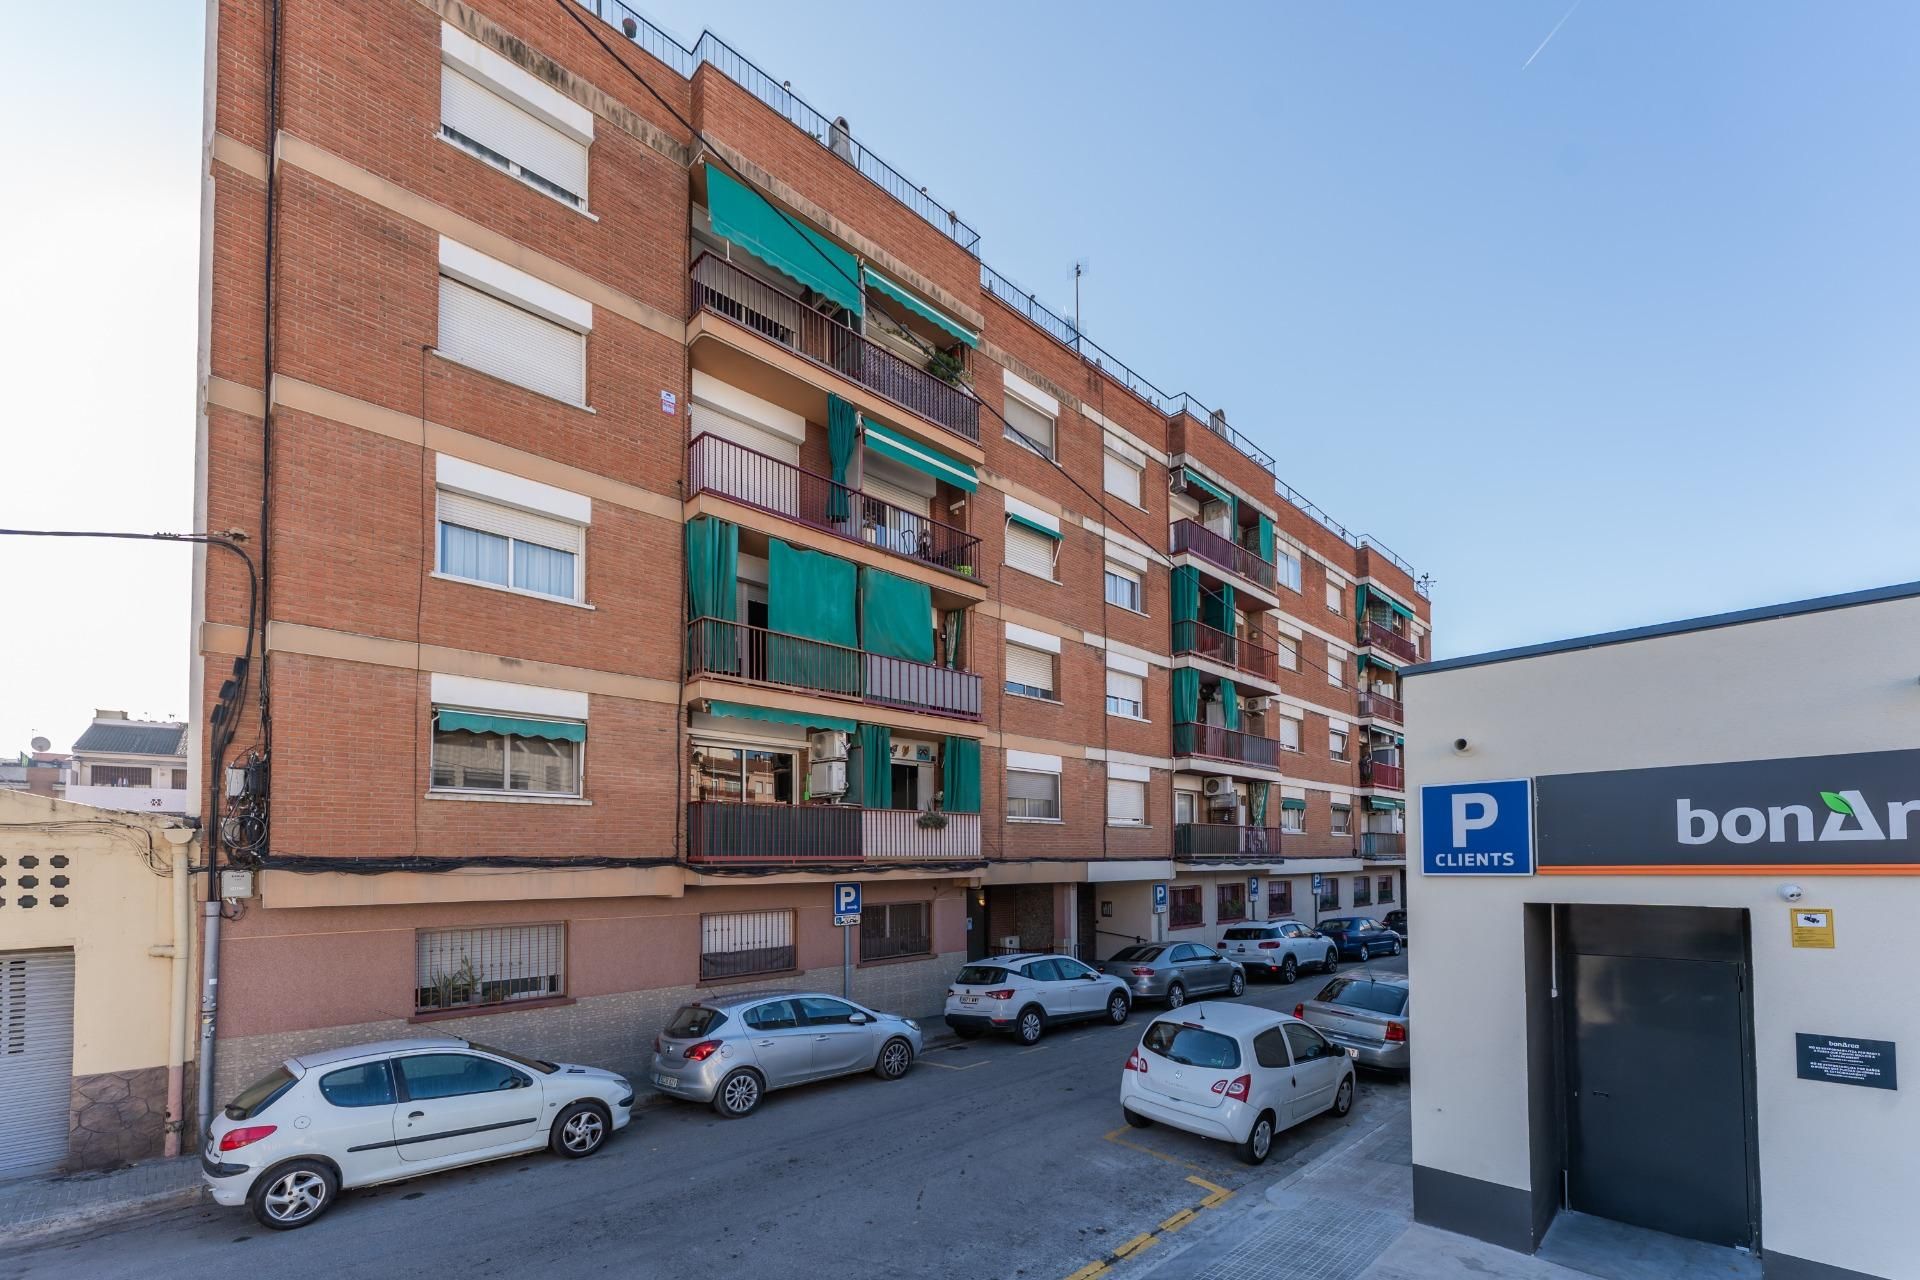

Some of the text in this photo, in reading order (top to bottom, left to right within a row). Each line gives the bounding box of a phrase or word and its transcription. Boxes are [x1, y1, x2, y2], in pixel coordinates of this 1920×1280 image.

[1451, 792, 1499, 848] P
[1435, 852, 1515, 867] CLIENTS
[1251, 878, 1257, 891] P
[841, 886, 856, 911] P
[1156, 886, 1164, 903] P
[1828, 1040, 1860, 1049] bonArea
